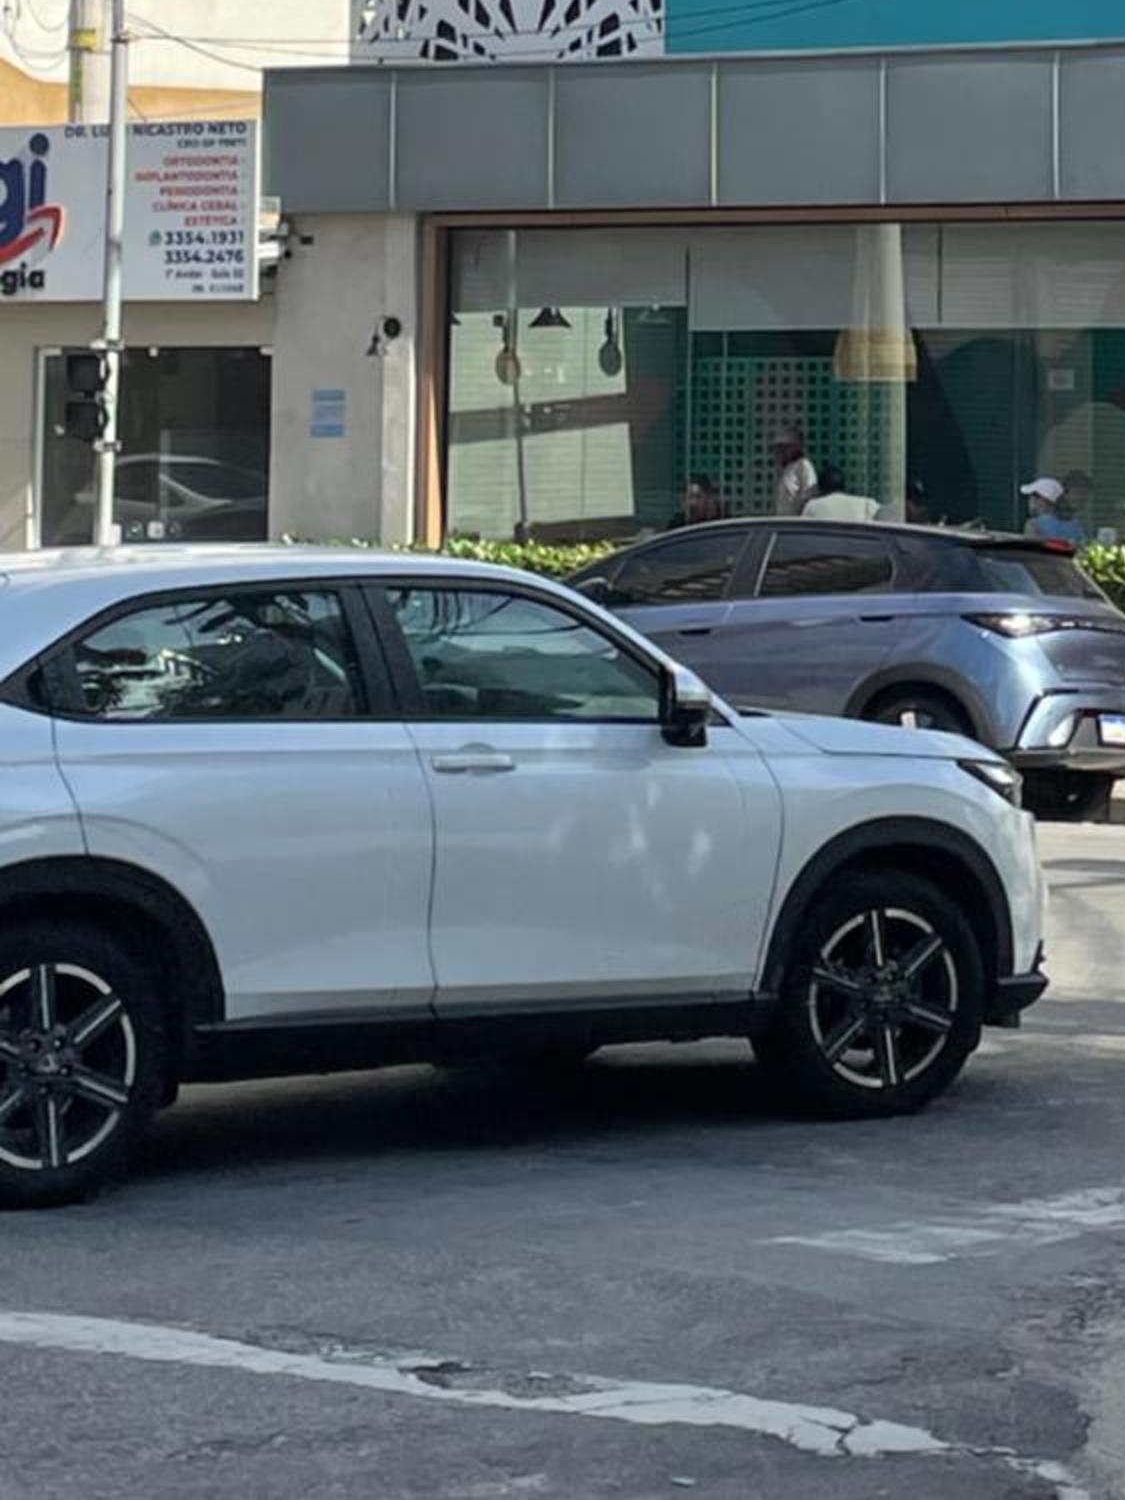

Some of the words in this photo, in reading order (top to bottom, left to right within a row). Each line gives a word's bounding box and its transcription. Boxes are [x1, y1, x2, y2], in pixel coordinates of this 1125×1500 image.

[132, 122, 204, 136] NICASTRO
[207, 121, 247, 135] NETO
[165, 230, 244, 245] 3354.1931
